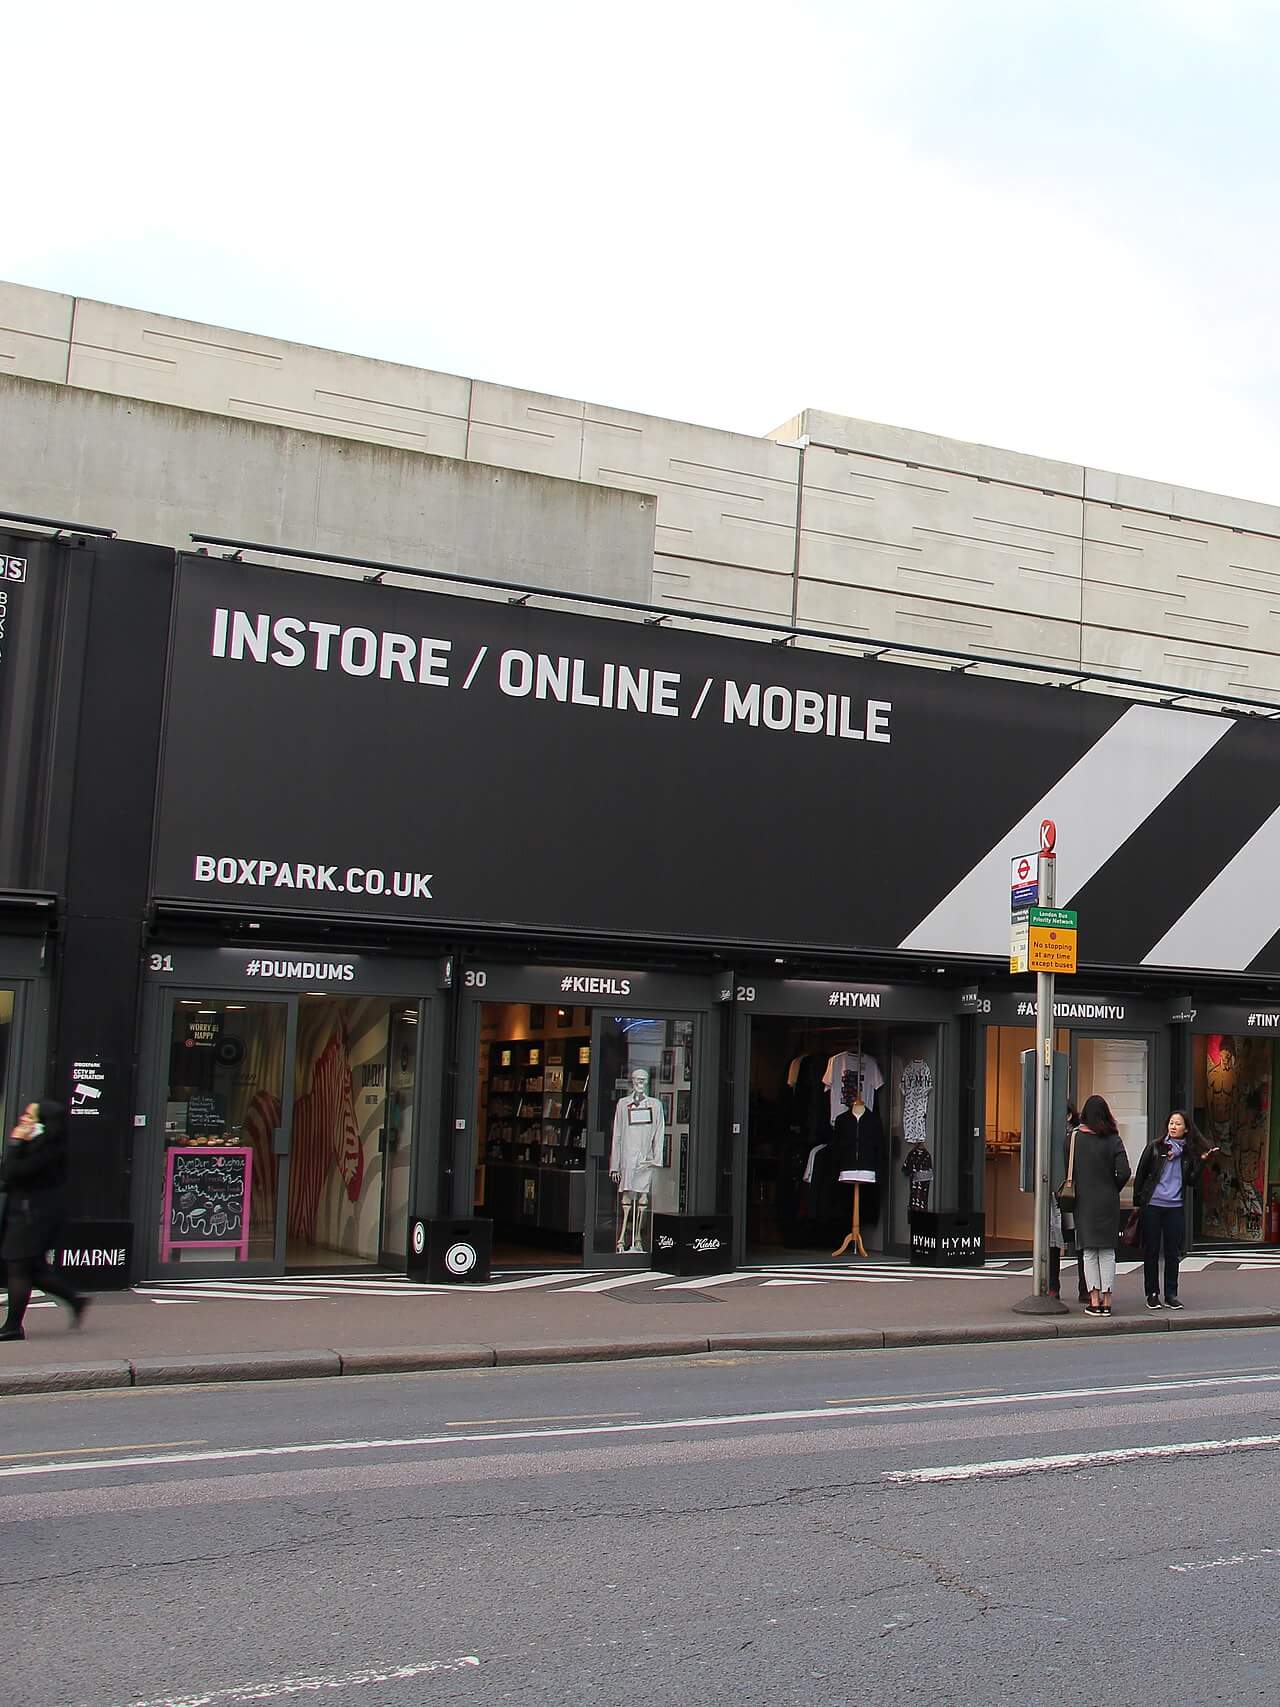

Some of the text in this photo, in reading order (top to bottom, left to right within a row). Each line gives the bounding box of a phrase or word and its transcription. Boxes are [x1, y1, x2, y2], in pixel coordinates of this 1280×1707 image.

[212, 608, 452, 687] INSTORE
[499, 649, 681, 717] ONLINE
[723, 679, 892, 743] MOBILE
[1041, 825, 1050, 848] K
[194, 855, 434, 899] BOXPARK.CO.UK
[1033, 941, 1073, 951] No stopping
[150, 954, 174, 972] 31
[1031, 960, 1073, 969] except buses
[1043, 952, 1055, 960] any
[1056, 952, 1070, 960] time
[246, 959, 355, 982] #DUMDUMS
[464, 970, 487, 987] 30
[560, 975, 631, 996] #KIEHLS
[736, 986, 756, 1001] 29
[828, 991, 880, 1008] #HYMN
[976, 999, 992, 1013] 28
[1016, 1001, 1125, 1020] #ASRIDANDMIYU
[942, 1236, 981, 1249] HYMN
[62, 1249, 118, 1266] IMARNI
